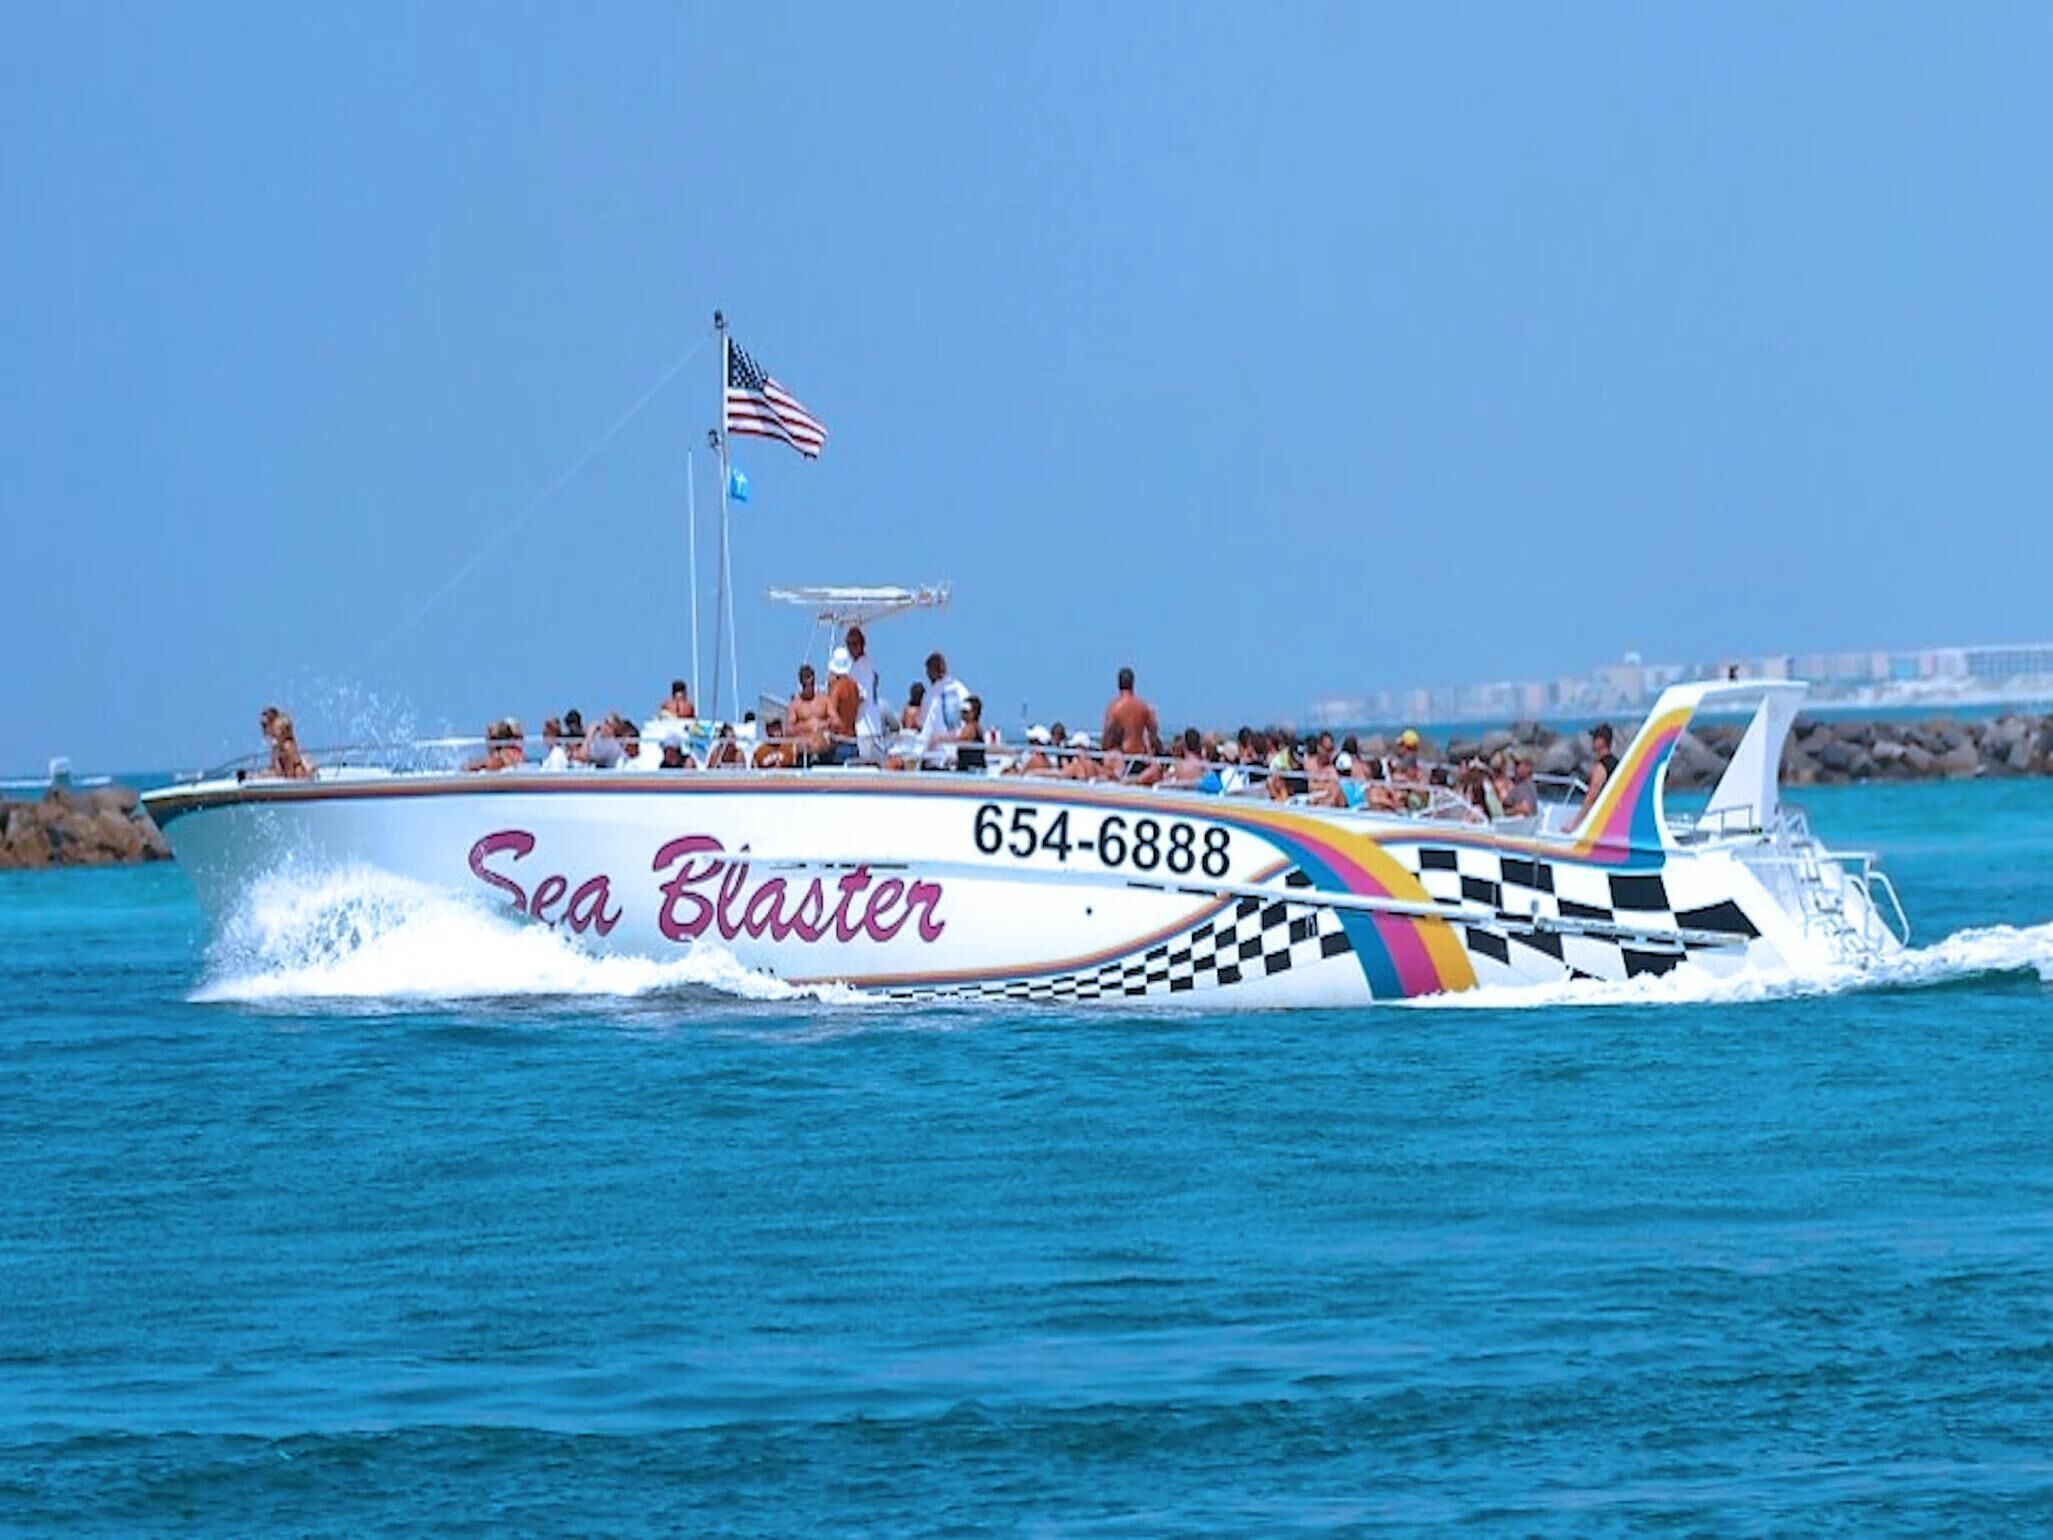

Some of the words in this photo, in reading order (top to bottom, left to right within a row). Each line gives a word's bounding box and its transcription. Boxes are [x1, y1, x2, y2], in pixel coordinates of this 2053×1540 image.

[467, 829, 622, 936] Sea
[652, 834, 944, 943] Blaster
[973, 803, 1231, 878] 654-6888
